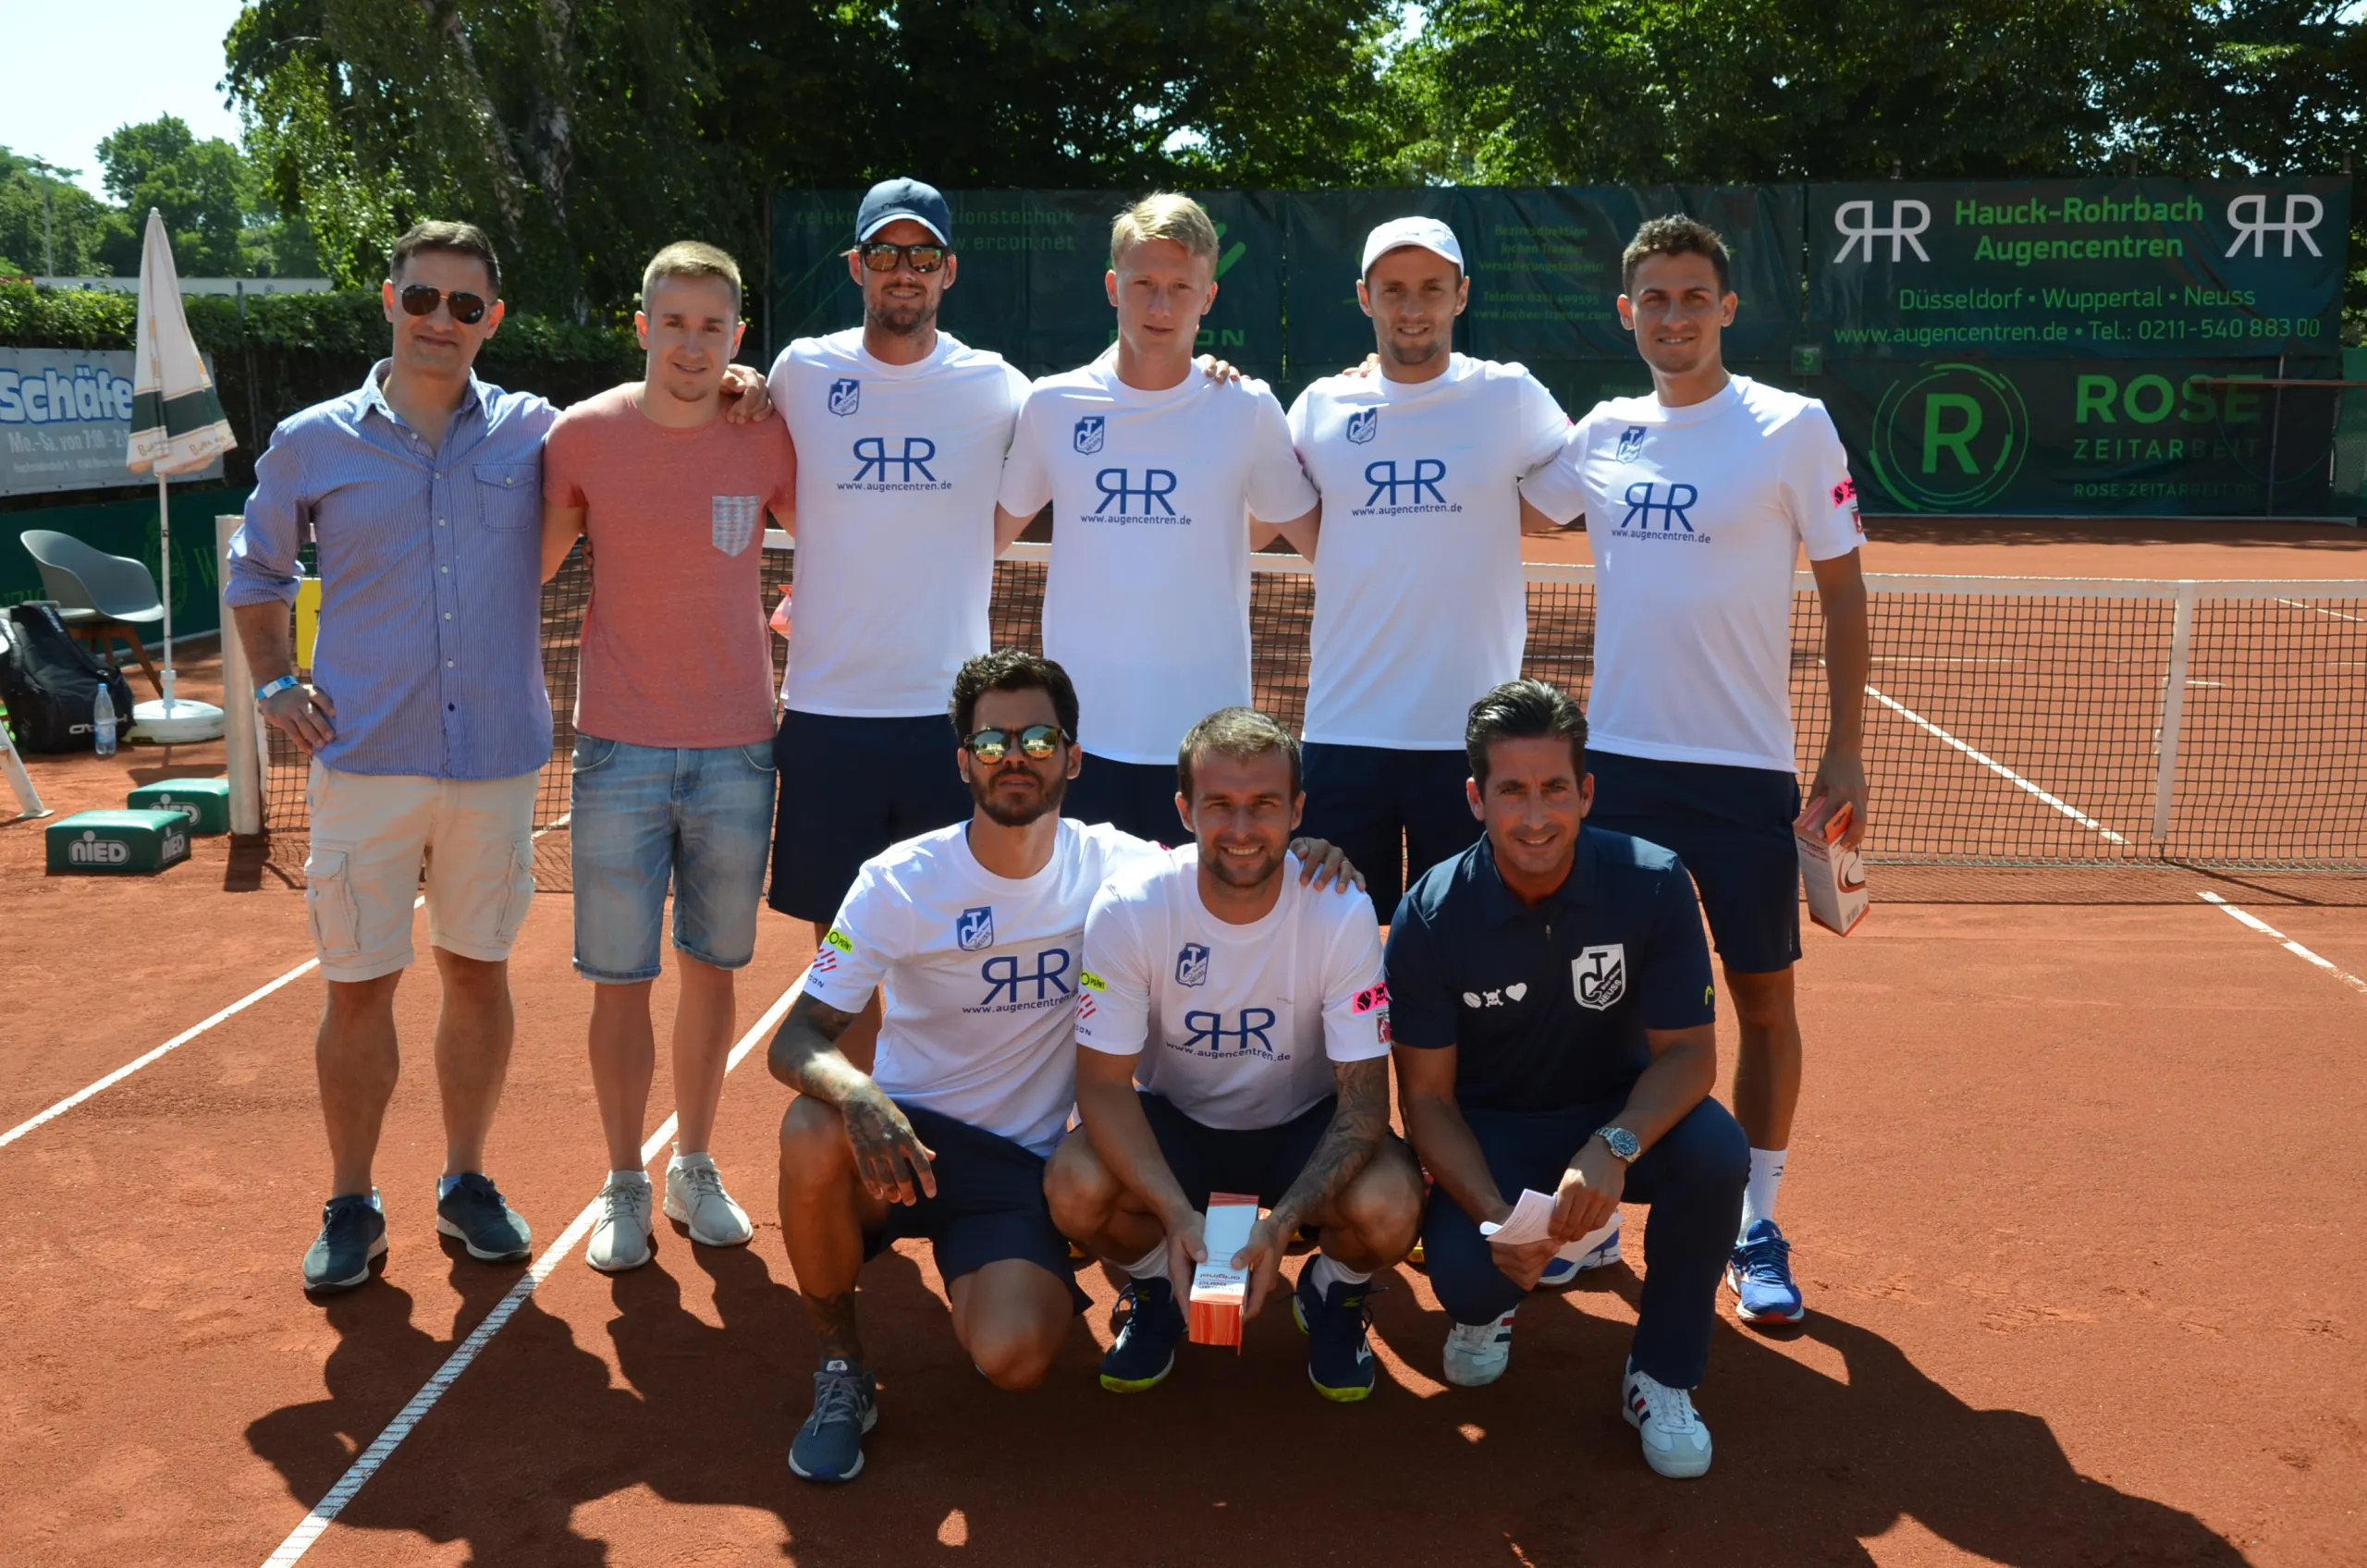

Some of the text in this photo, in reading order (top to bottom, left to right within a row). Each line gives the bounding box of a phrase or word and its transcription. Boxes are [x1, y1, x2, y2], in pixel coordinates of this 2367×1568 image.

[1956, 194, 2203, 227] Hauck-Rohrbach
[1974, 235, 2183, 266] Augencentren
[1484, 291, 1524, 302] Telefon
[1899, 287, 2256, 312] Düsseldorf Wuppertal Neuss
[1834, 322, 2067, 348] www.augencentren.de
[2088, 321, 2132, 339] Tel.:
[0, 365, 133, 423] Schäfe
[2076, 374, 2264, 424] ROSE
[1922, 393, 1982, 474] R
[837, 481, 952, 493] www.augencentren.de
[1080, 515, 1193, 526] www.augencentren.de
[1352, 503, 1464, 517] www.augencentren.de
[1611, 530, 1712, 545] www.augencentren.de
[962, 993, 1079, 1014] www.augencentren.
[1598, 979, 1622, 1005] NEUSS
[1166, 1041, 1291, 1061] www.augencentren.de
